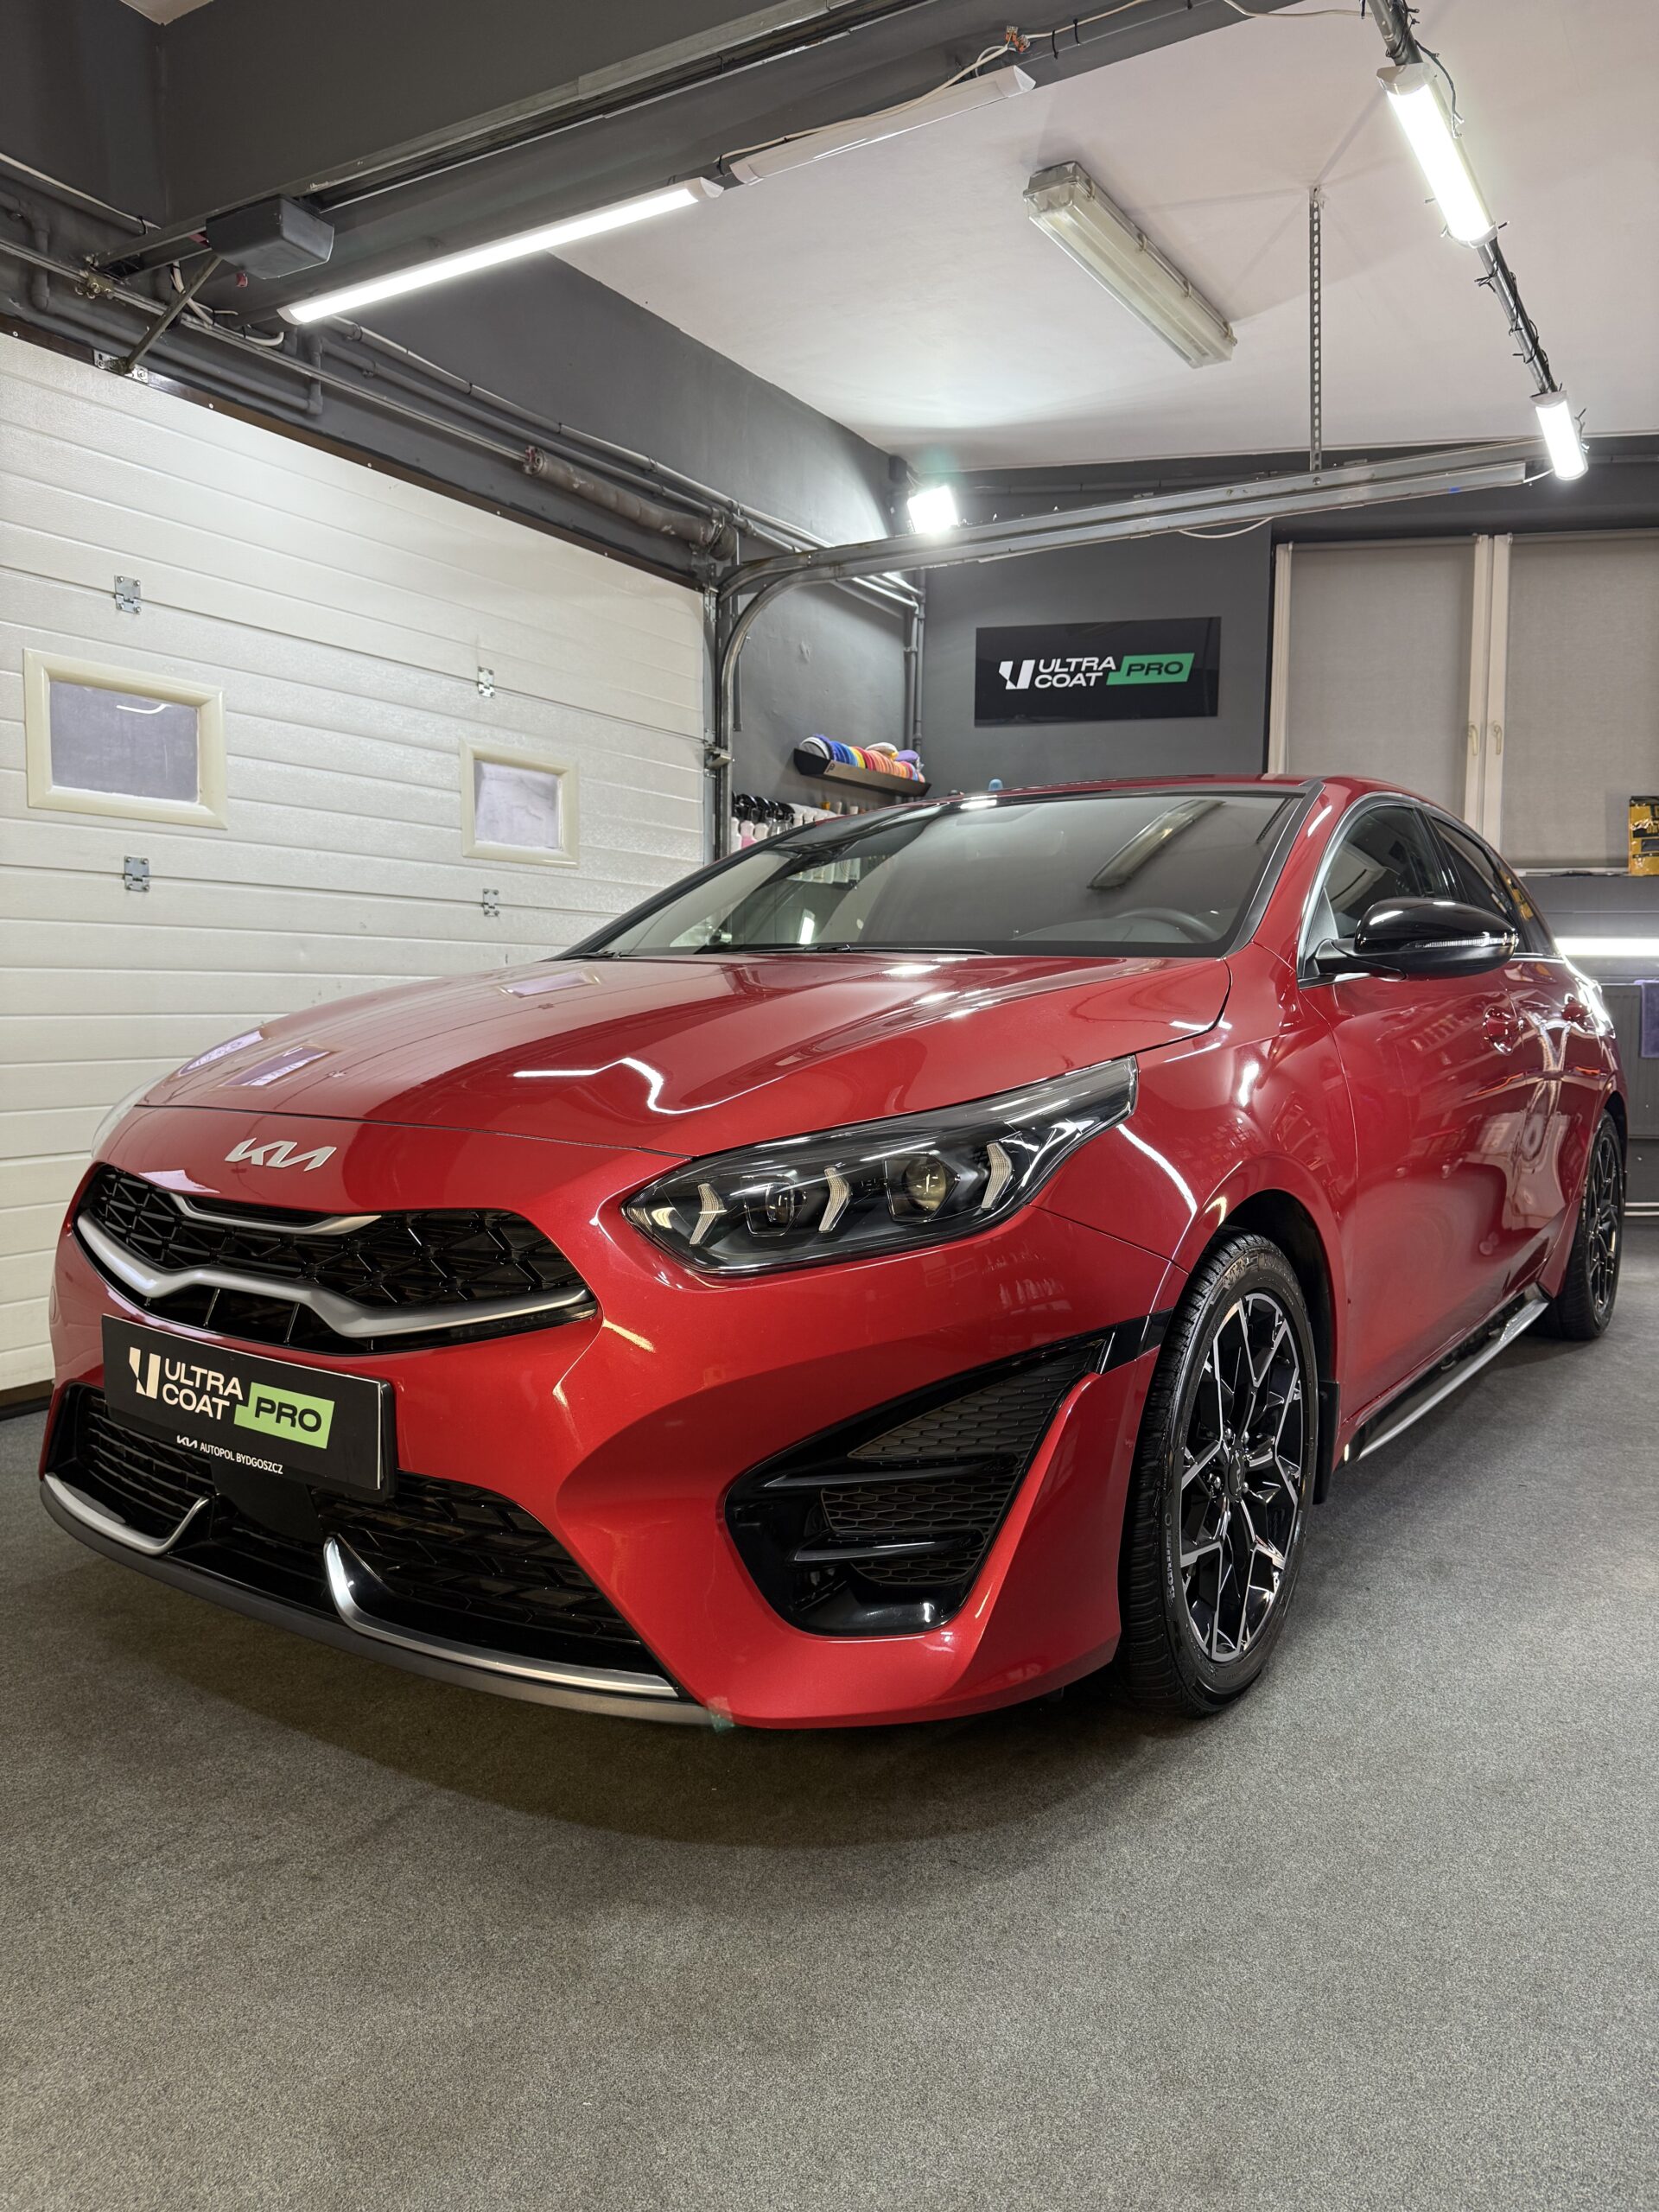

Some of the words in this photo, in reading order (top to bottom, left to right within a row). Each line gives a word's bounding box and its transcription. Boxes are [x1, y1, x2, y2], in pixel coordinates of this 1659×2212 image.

[1034, 672, 1103, 689] COAT
[1038, 656, 1117, 673] ULTRA
[1126, 661, 1184, 677] PRO
[164, 1357, 244, 1401] ULTRA
[162, 1383, 230, 1420] COAT
[254, 1396, 322, 1433] PRO
[200, 1442, 235, 1461] AUTOPOL
[236, 1452, 283, 1475] BYDGOSZCZ
